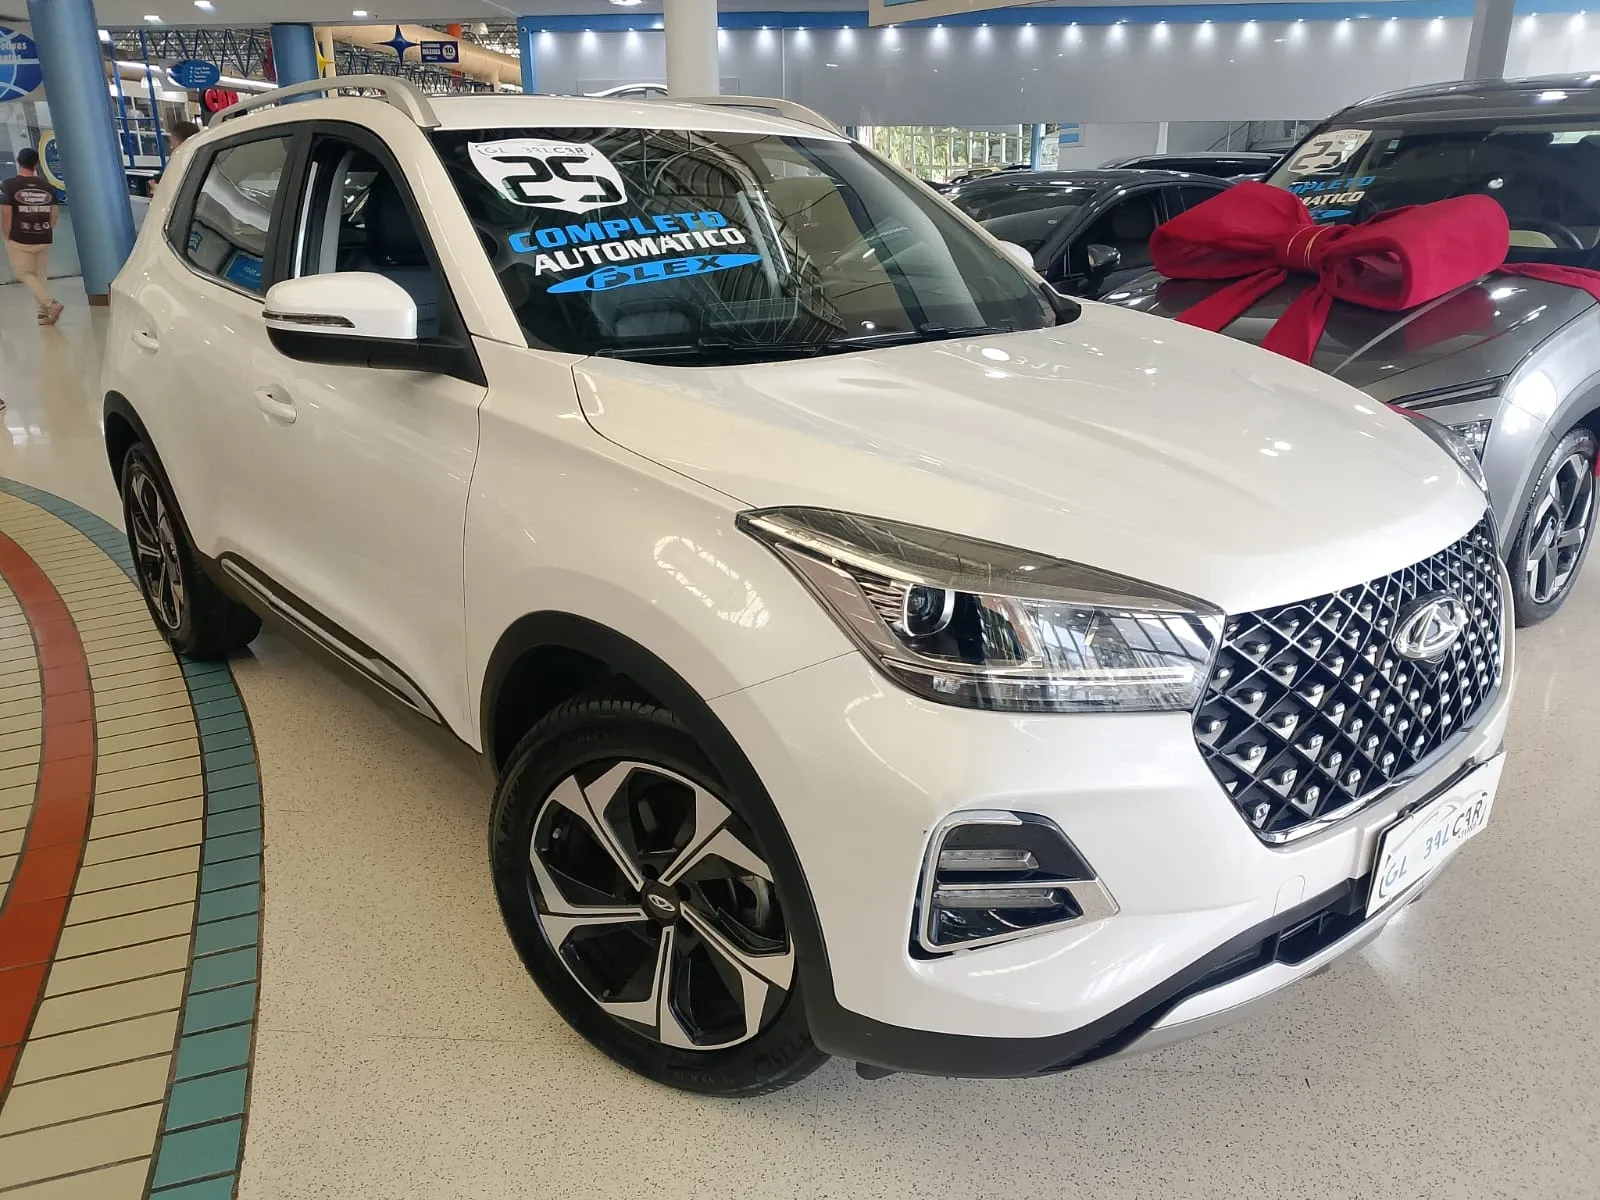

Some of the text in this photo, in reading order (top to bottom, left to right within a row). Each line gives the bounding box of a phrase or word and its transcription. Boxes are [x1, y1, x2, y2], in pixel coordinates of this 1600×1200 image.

[491, 155, 623, 204] 25
[508, 211, 728, 254] COMPLETO
[592, 256, 721, 289] FLEX
